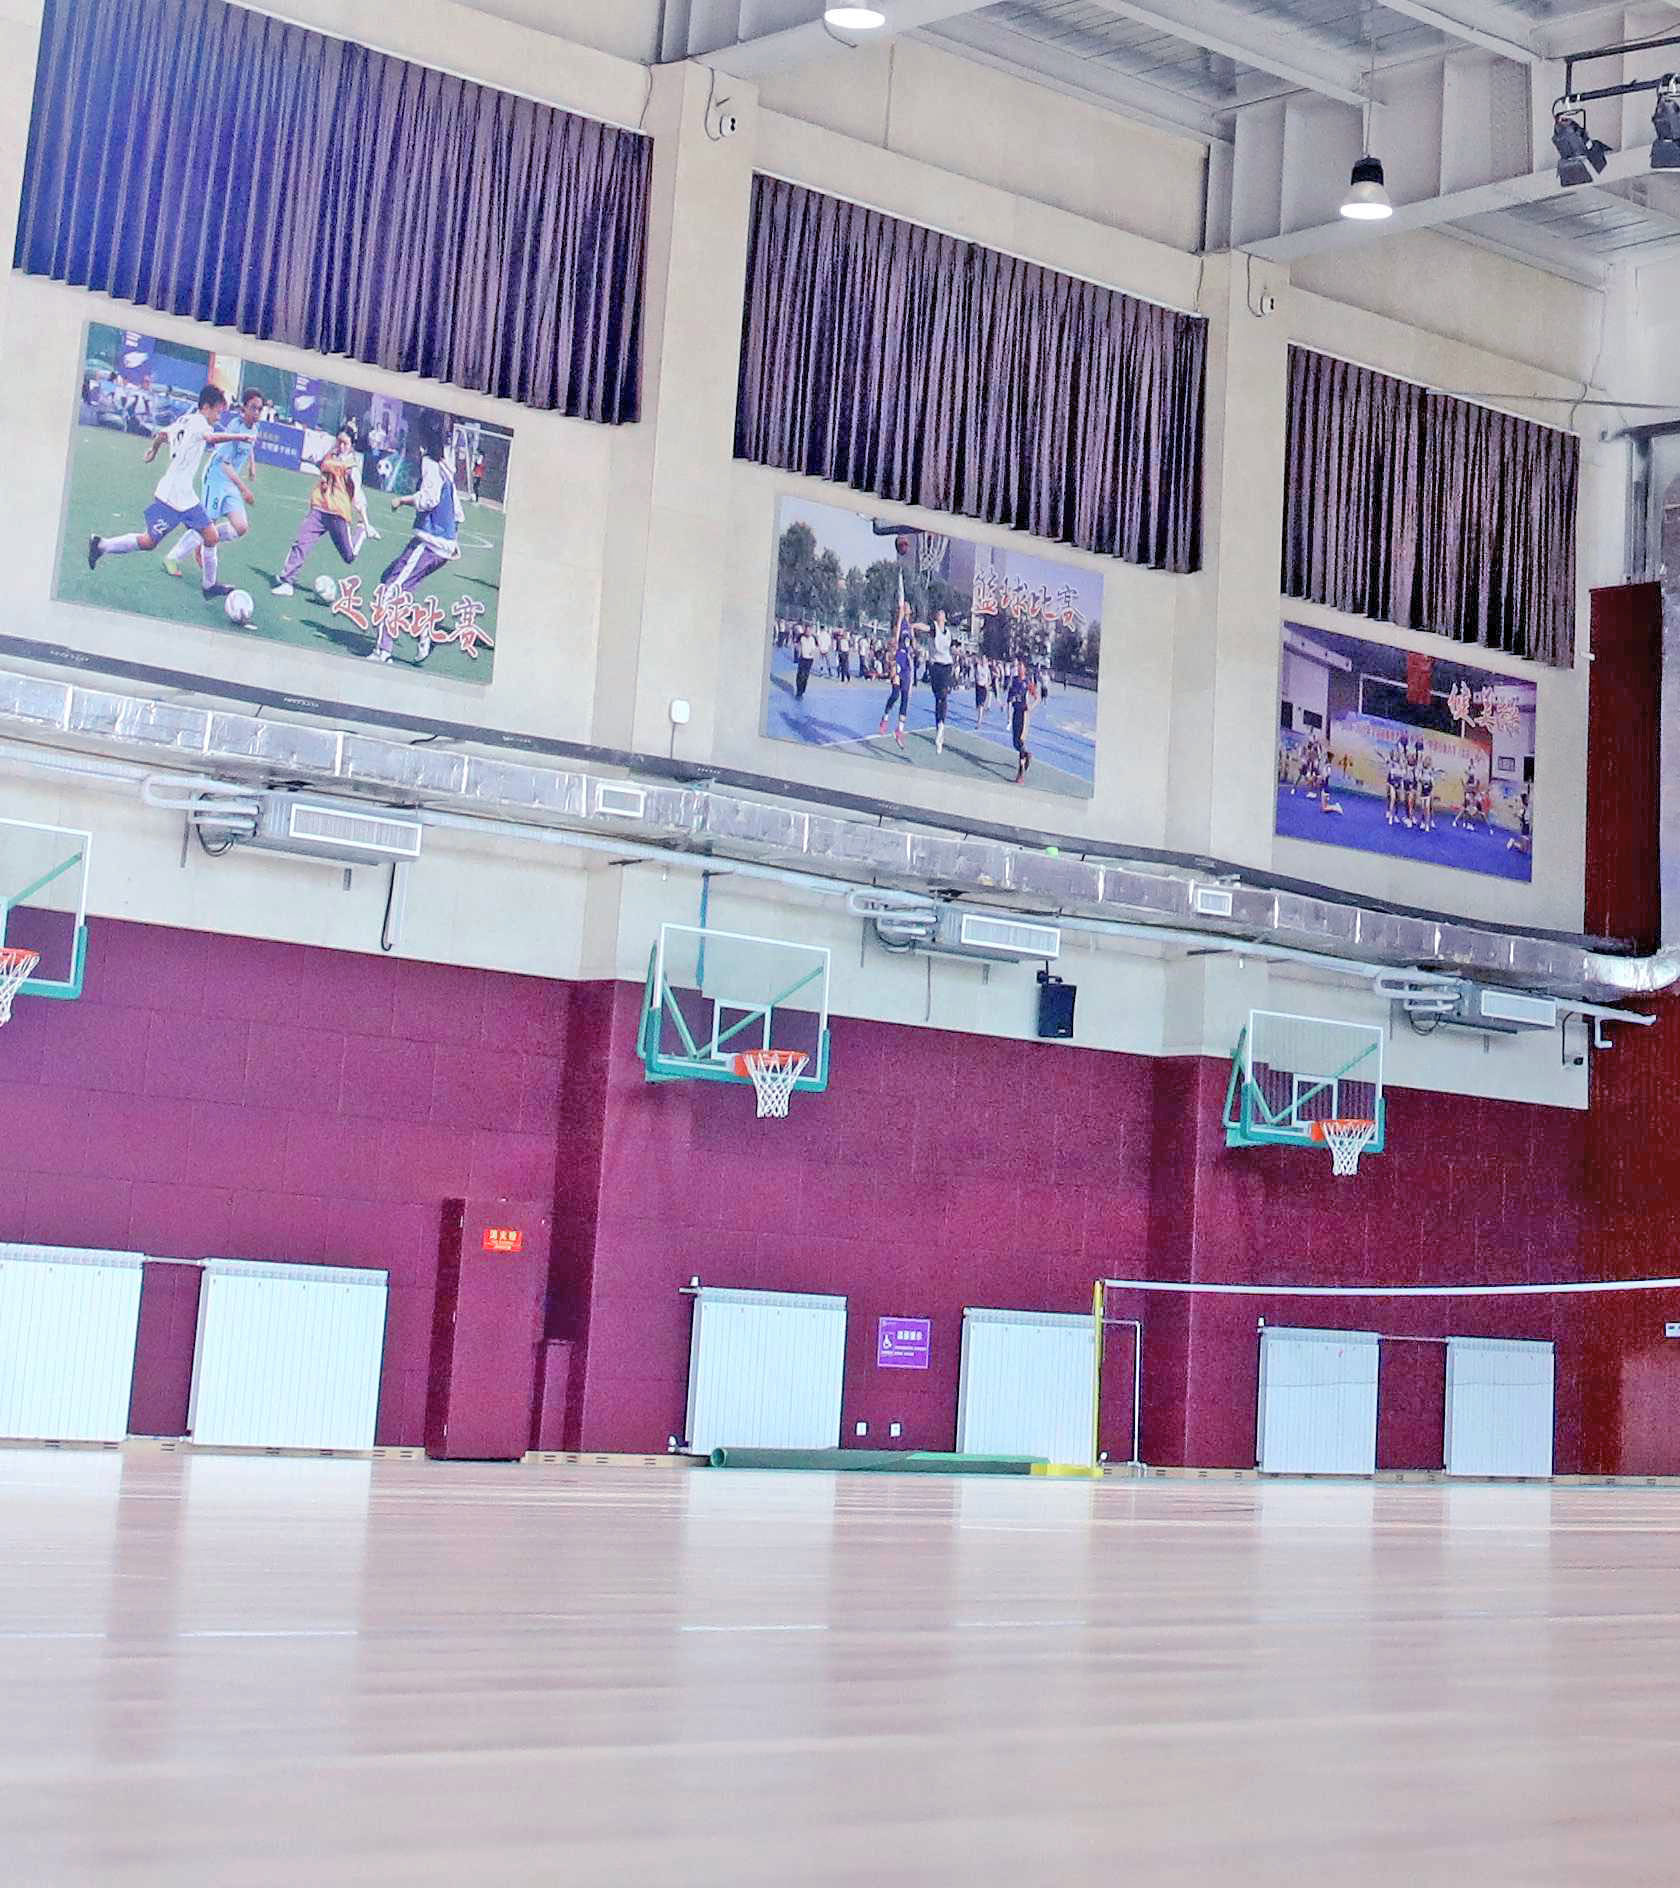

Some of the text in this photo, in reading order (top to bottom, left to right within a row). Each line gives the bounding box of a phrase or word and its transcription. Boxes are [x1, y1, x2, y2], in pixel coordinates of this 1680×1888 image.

[332, 574, 495, 659] 足球比赛
[971, 565, 1089, 633] 篮球比赛
